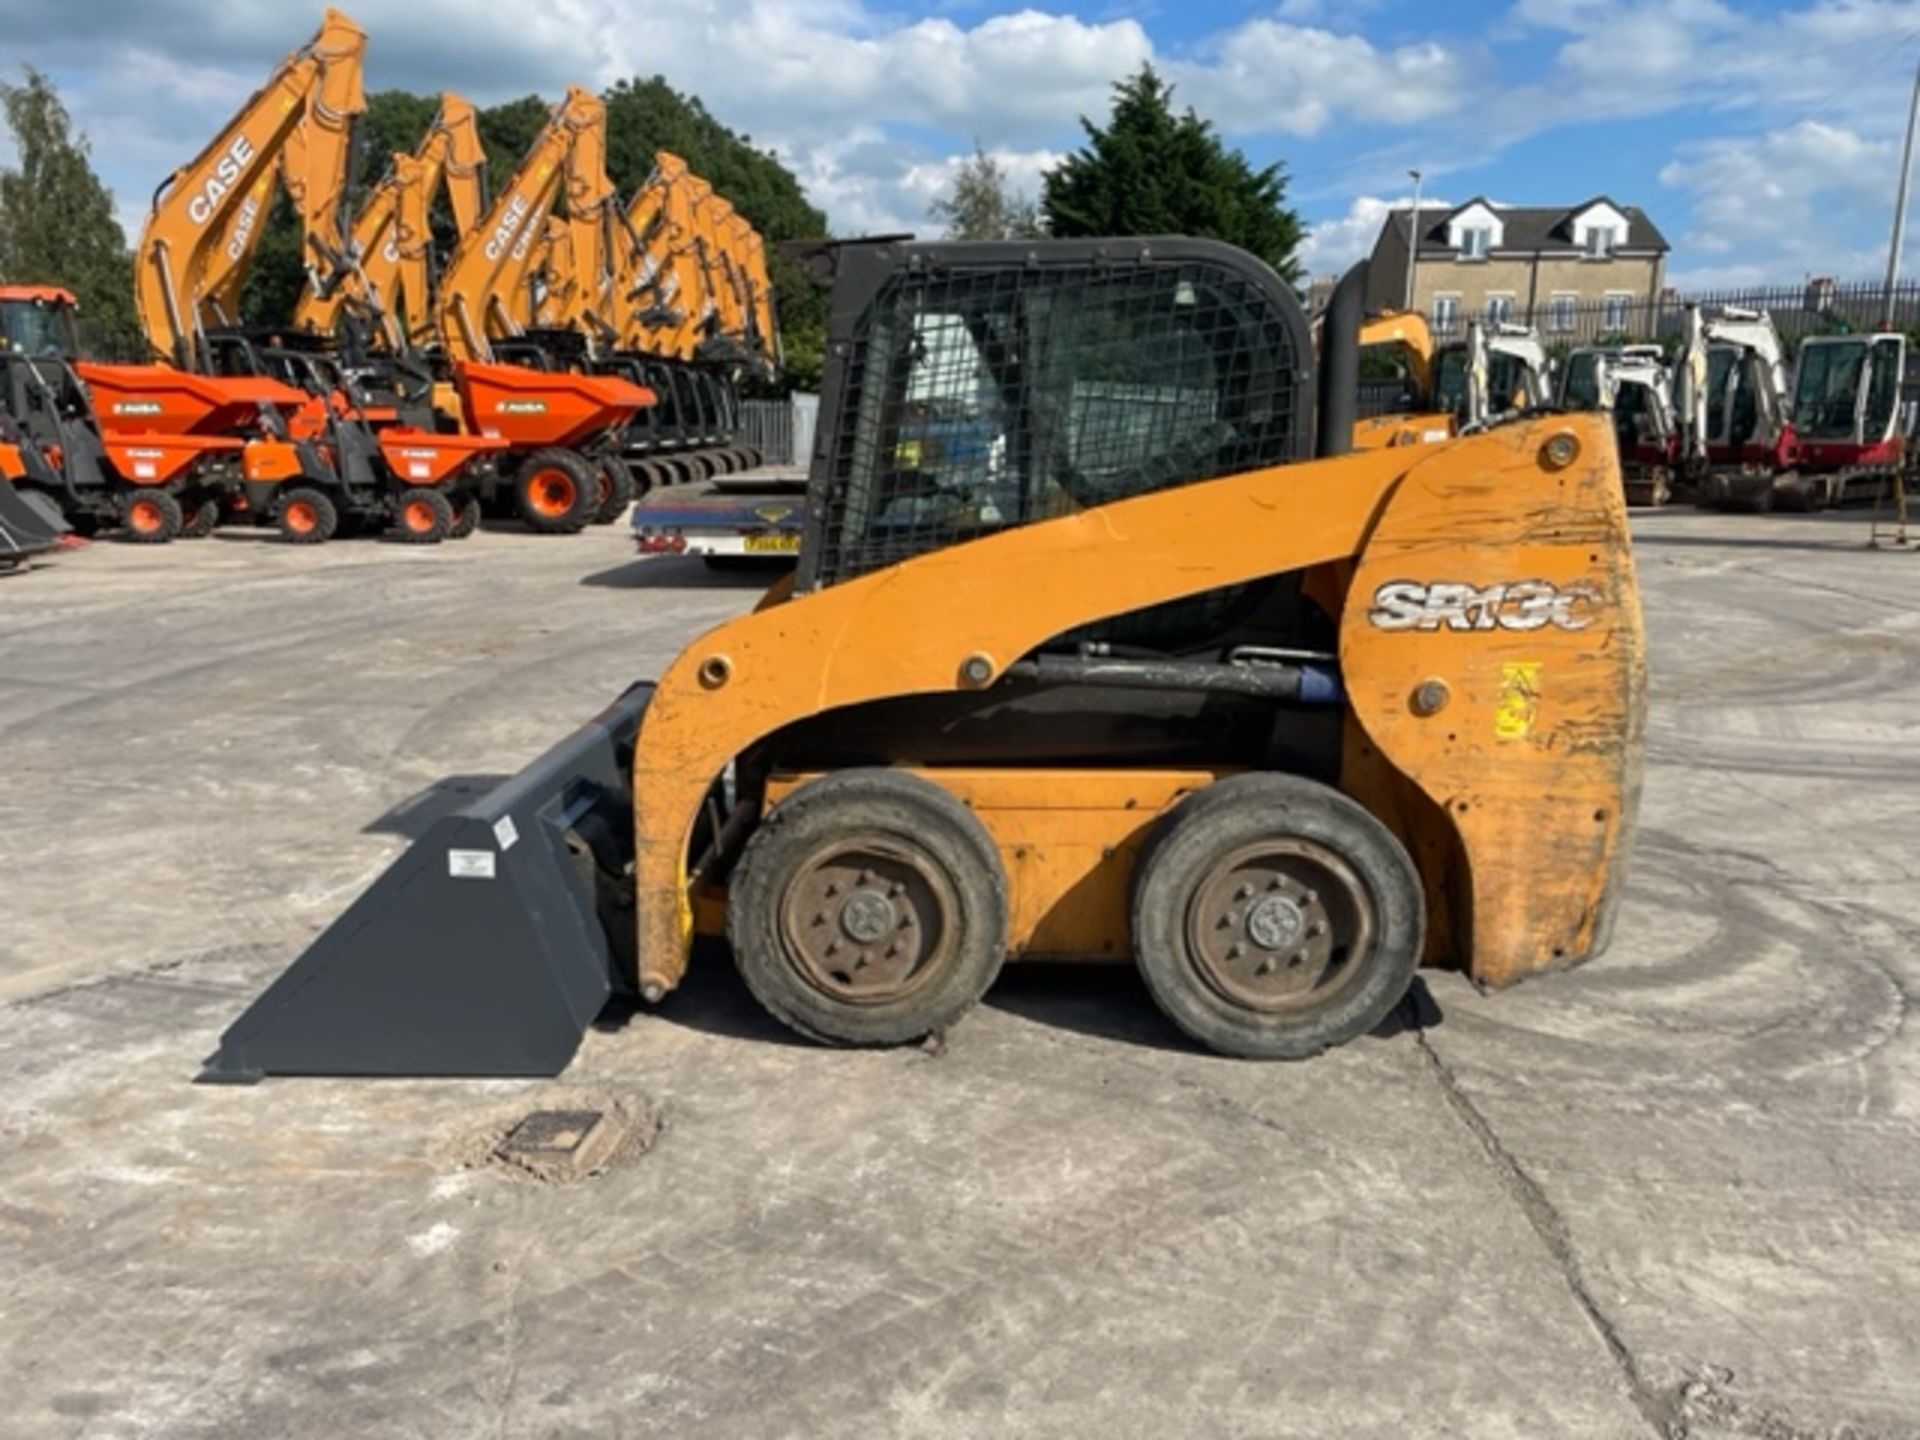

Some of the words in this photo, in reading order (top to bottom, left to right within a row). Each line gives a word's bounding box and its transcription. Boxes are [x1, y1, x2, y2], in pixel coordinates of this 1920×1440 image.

[189, 136, 254, 222] CASE
[227, 197, 258, 260] CASE
[486, 195, 528, 259] CASE
